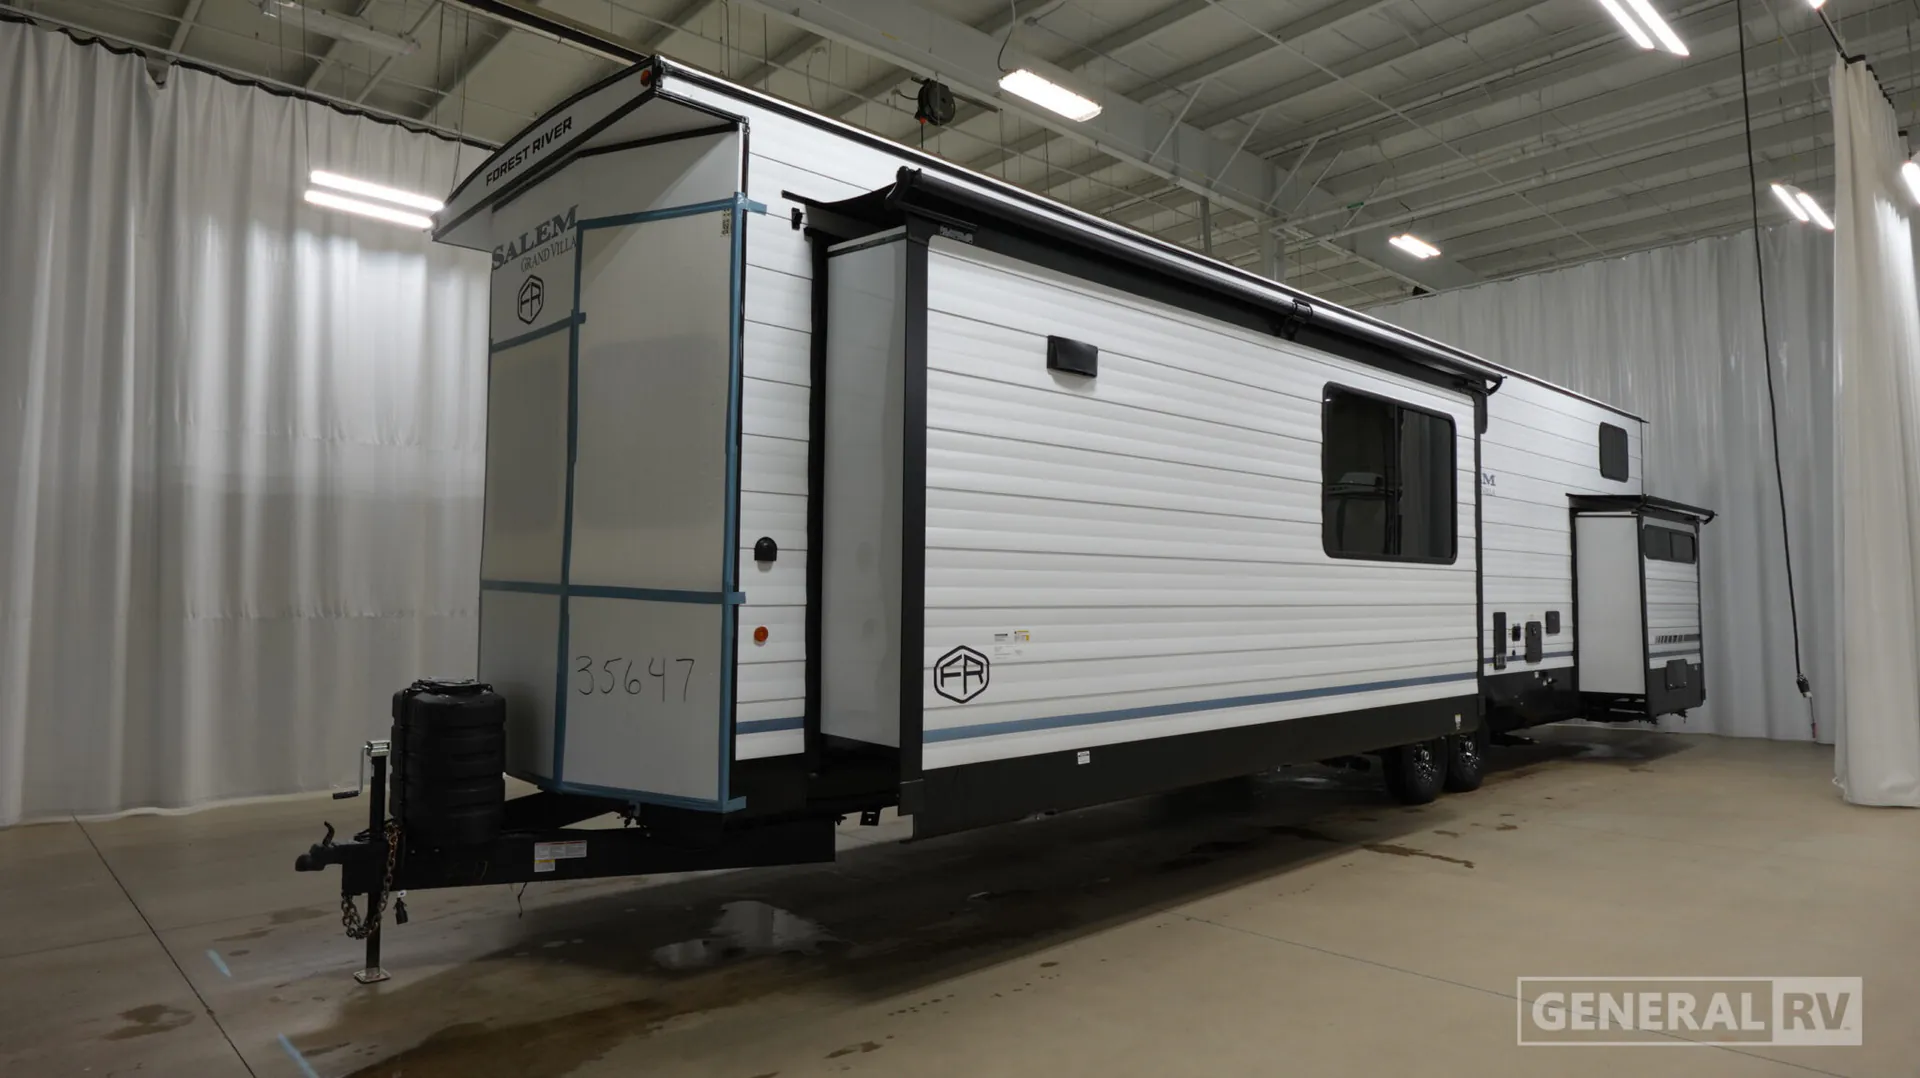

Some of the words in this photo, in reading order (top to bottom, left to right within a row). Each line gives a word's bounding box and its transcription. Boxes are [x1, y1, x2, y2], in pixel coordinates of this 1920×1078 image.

[486, 146, 530, 187] FOREST
[532, 116, 573, 154] RIVER
[492, 204, 578, 271] SALEM
[521, 247, 550, 272] GRAND
[550, 236, 577, 258] VILLA
[575, 655, 695, 703] 35647
